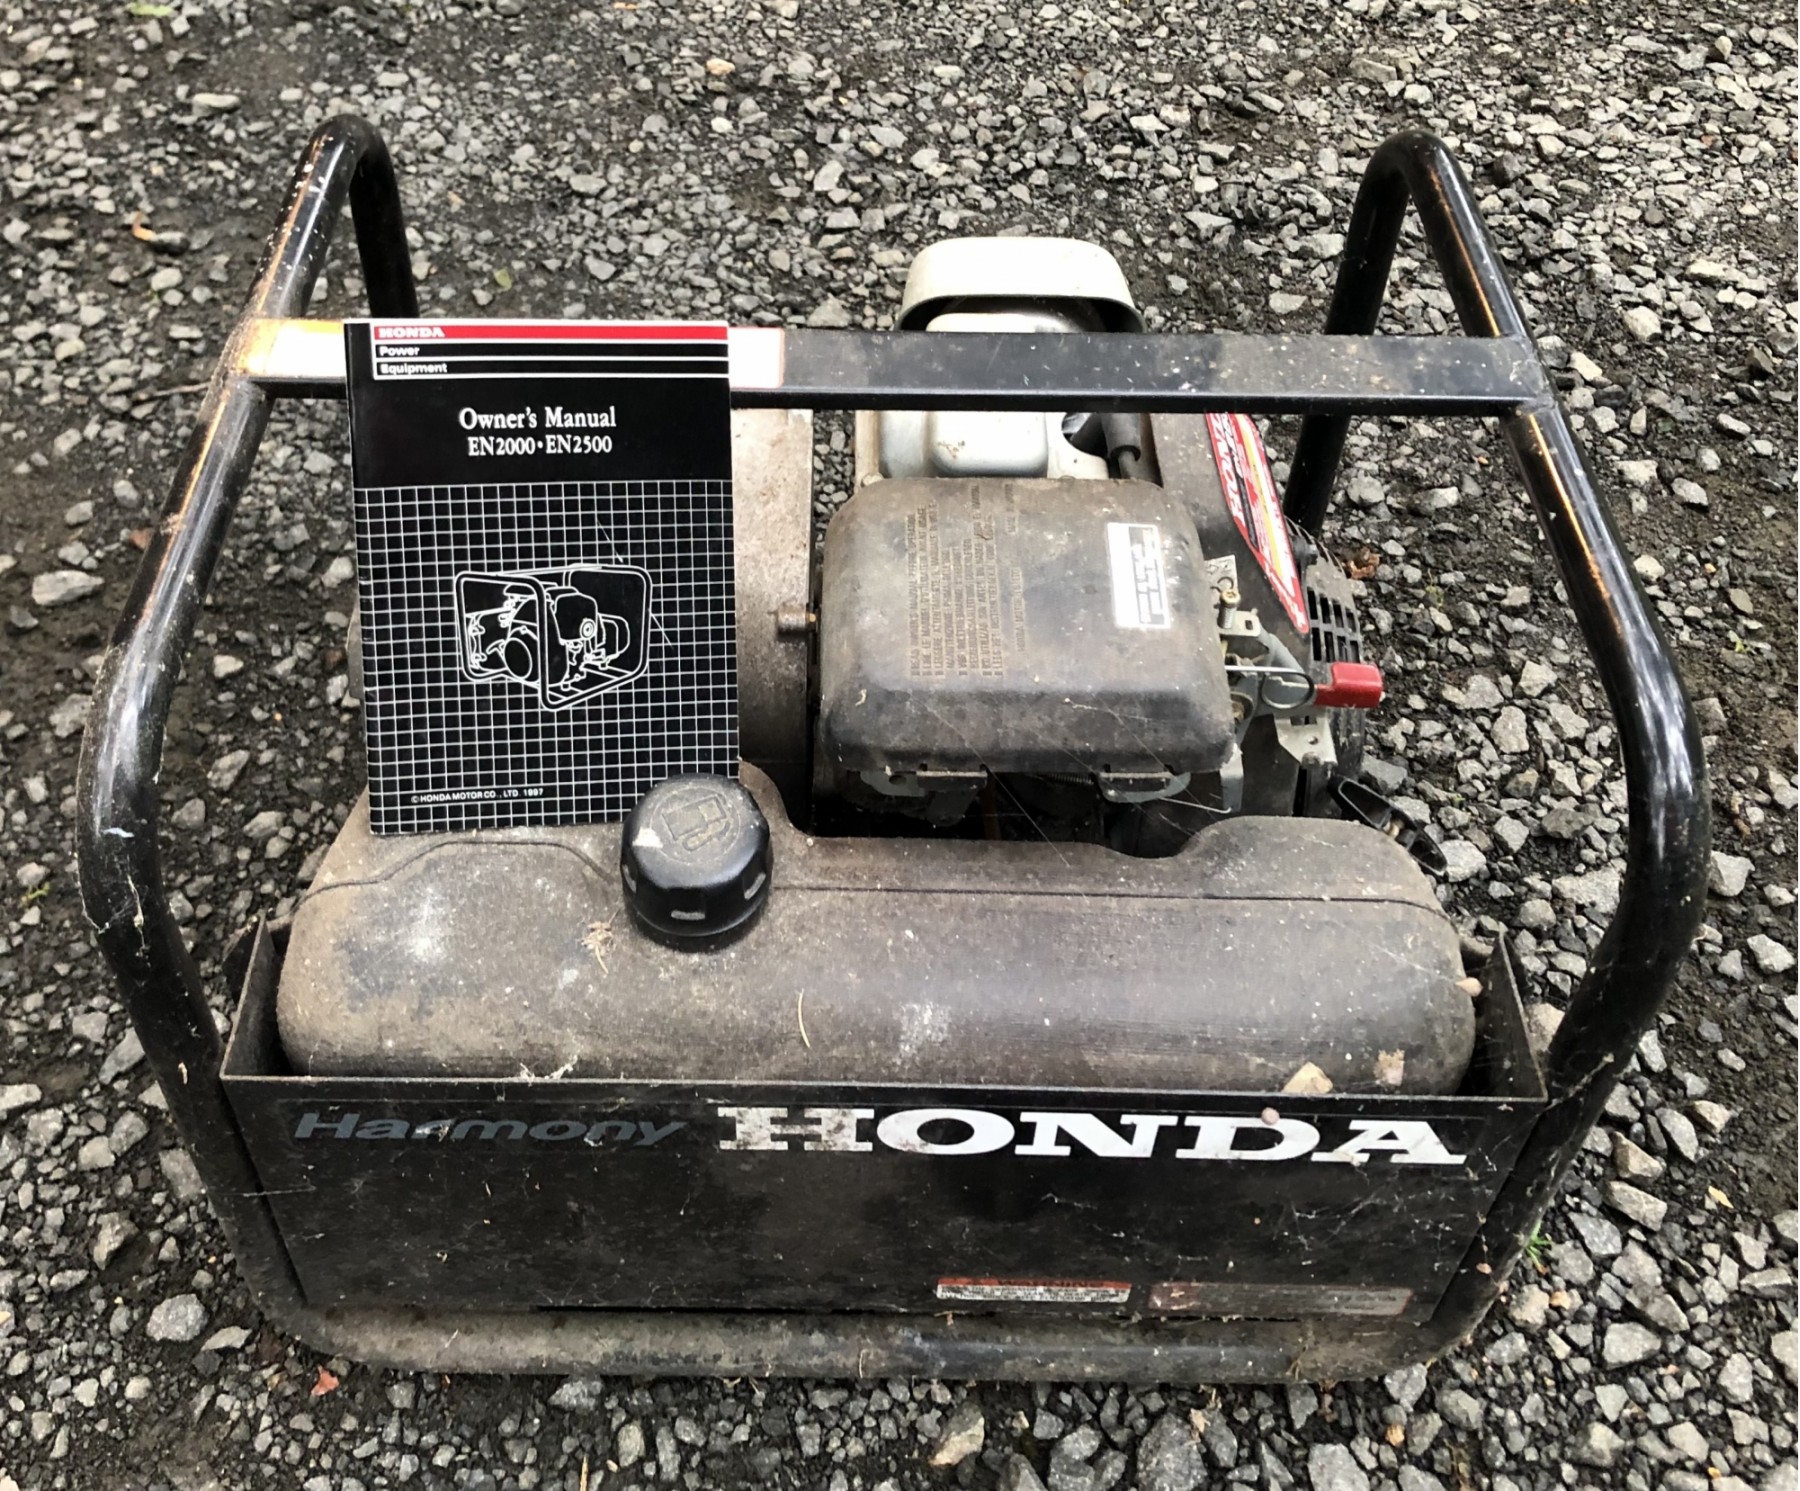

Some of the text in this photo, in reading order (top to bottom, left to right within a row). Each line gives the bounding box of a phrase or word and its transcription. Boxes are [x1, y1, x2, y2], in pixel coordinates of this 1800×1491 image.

[378, 326, 445, 339] HONDA
[379, 345, 420, 357] Power
[380, 361, 448, 376] Equipment
[458, 405, 617, 431] Owner's Manual
[420, 792, 451, 803] HONDA
[451, 790, 483, 801] MOTOR
[523, 787, 544, 797] 1997
[294, 1111, 688, 1147] Harmony
[717, 1106, 1468, 1165] HONDA
